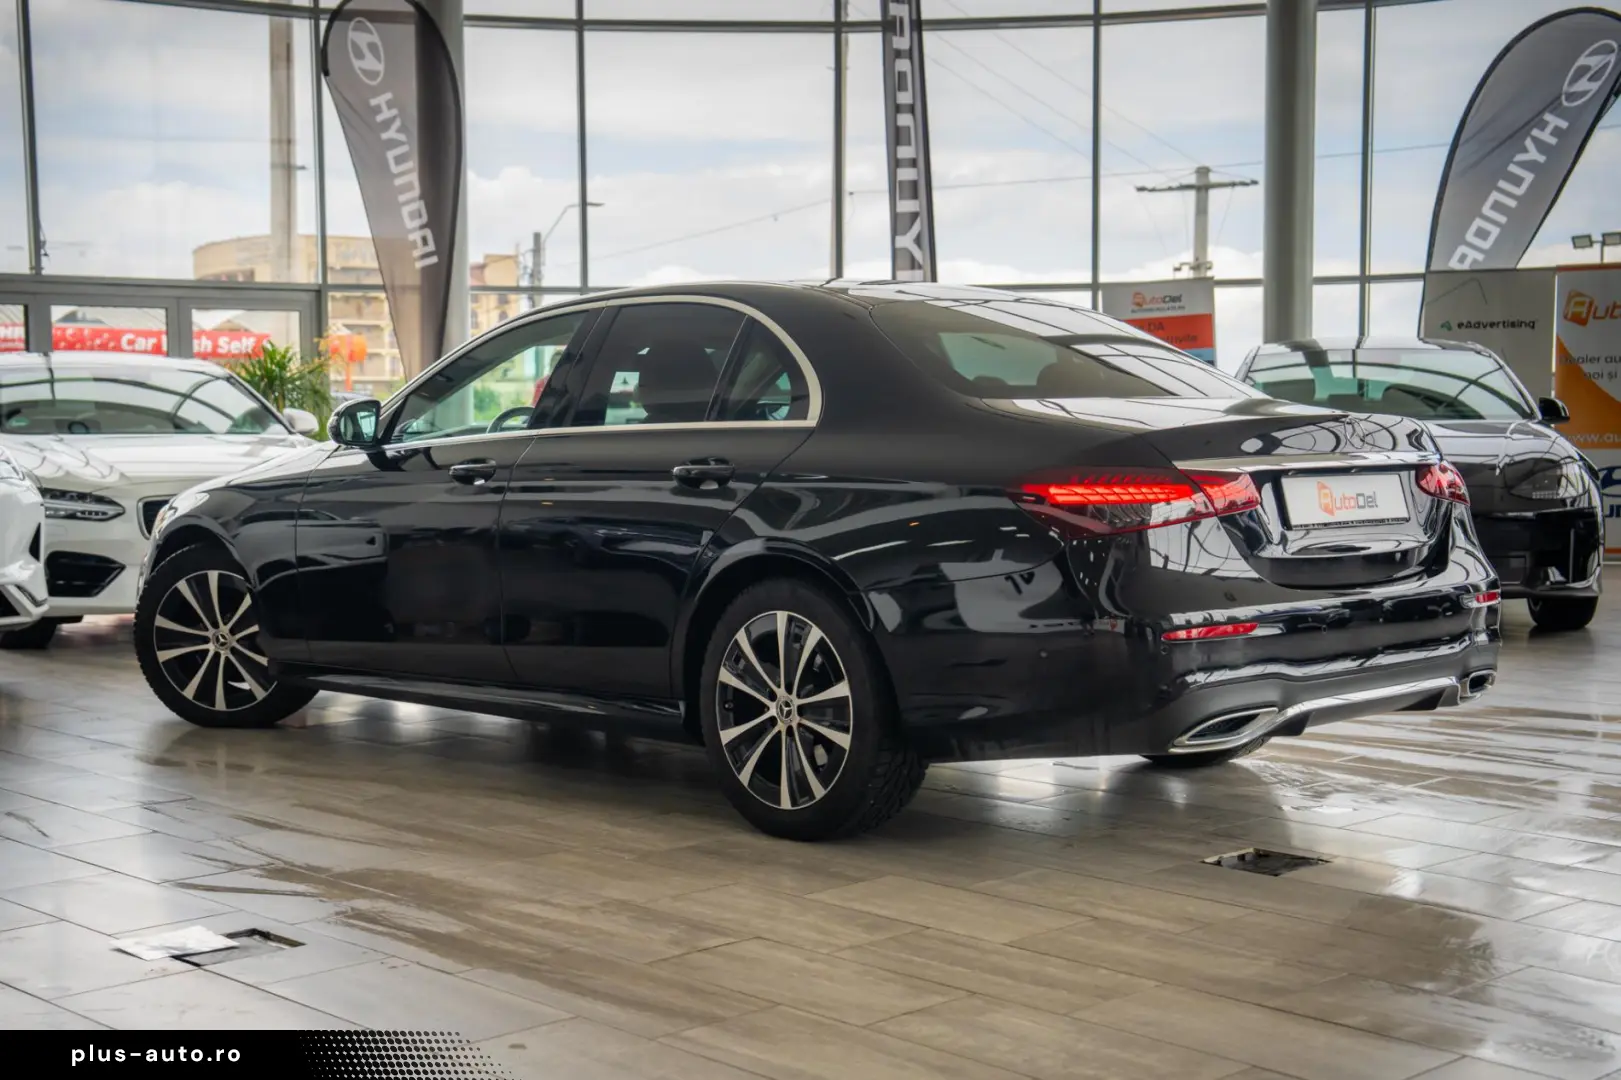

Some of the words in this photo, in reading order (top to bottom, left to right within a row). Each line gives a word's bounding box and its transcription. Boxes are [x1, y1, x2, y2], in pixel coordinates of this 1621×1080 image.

[369, 92, 439, 269] HYUNDAI
[1457, 319, 1536, 330] eAdvertising
[120, 333, 157, 351] Car
[217, 336, 256, 355] Self
[1317, 482, 1378, 515] AutoDel
